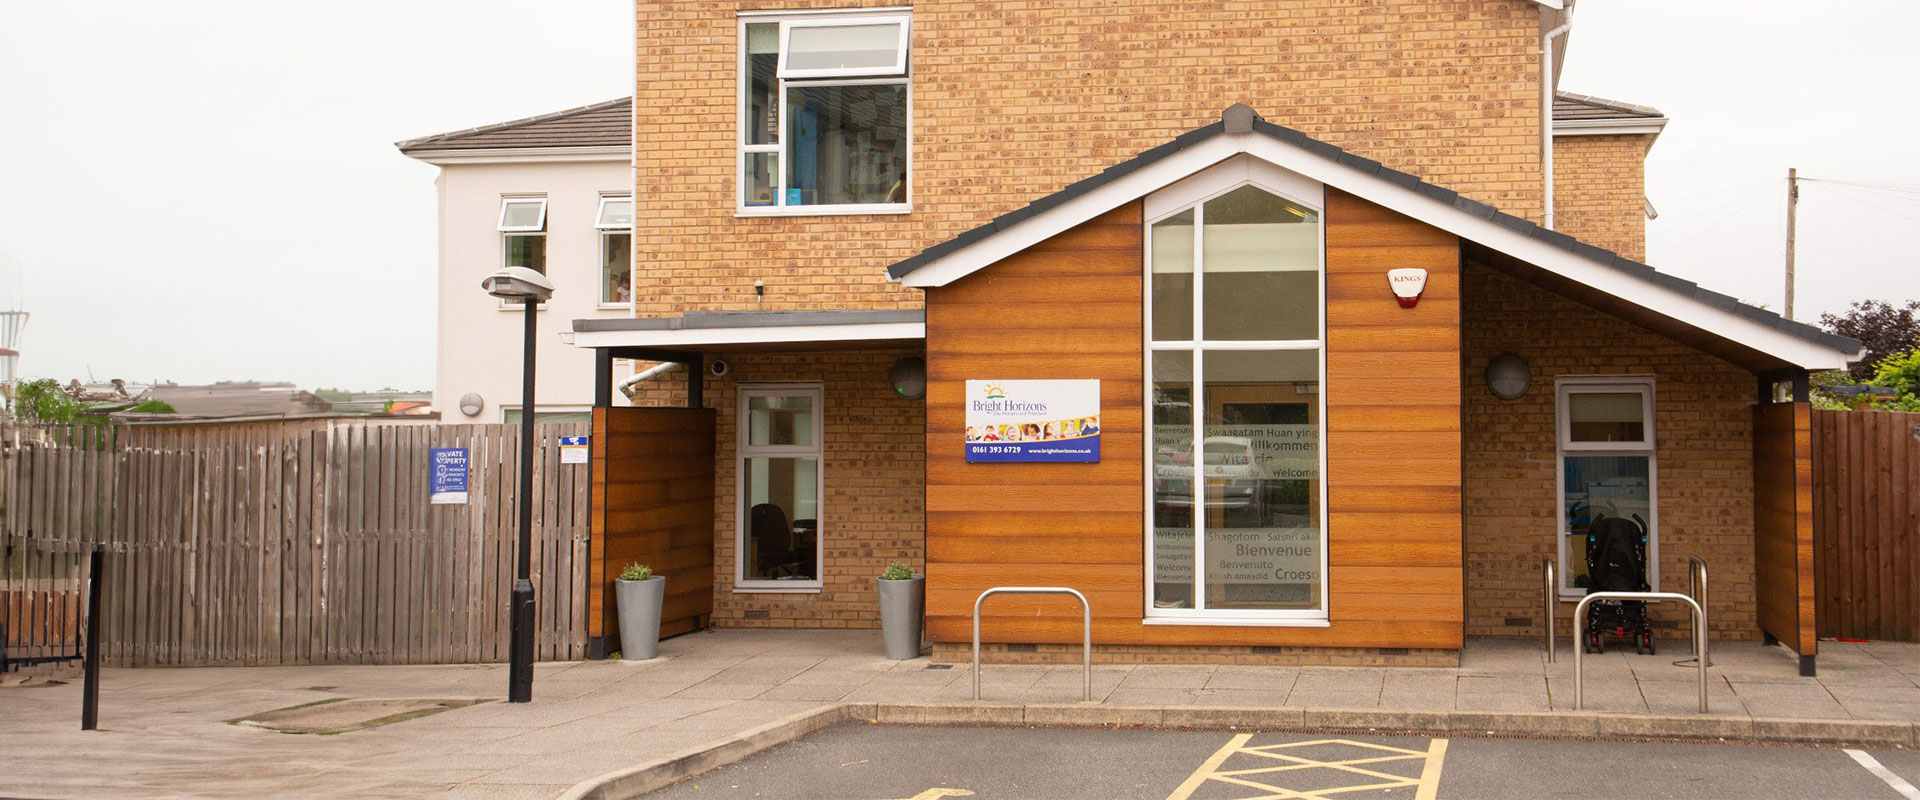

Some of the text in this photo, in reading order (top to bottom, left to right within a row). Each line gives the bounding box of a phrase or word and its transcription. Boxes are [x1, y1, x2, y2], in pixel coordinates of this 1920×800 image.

[973, 400, 1048, 413] Bright Horizons
[1154, 426, 1193, 434] Benvenuto
[1208, 428, 1318, 439] Swaagatam Huan ying
[1155, 437, 1175, 445] Huan
[972, 446, 987, 454] 0161
[989, 446, 1002, 454] 393
[1003, 446, 1021, 454] 6729
[1219, 453, 1274, 465] Witacie
[1155, 466, 1194, 477] Croeso
[1272, 468, 1318, 477] Welcome
[1155, 531, 1194, 541] Witajcie
[1208, 532, 1260, 543] Shagotom
[1267, 533, 1298, 541] Satshri
[1236, 544, 1312, 557] Bienvenue
[1155, 563, 1193, 571] Welcome
[1219, 560, 1274, 569] Benvenuto
[1275, 568, 1320, 580] Croeso
